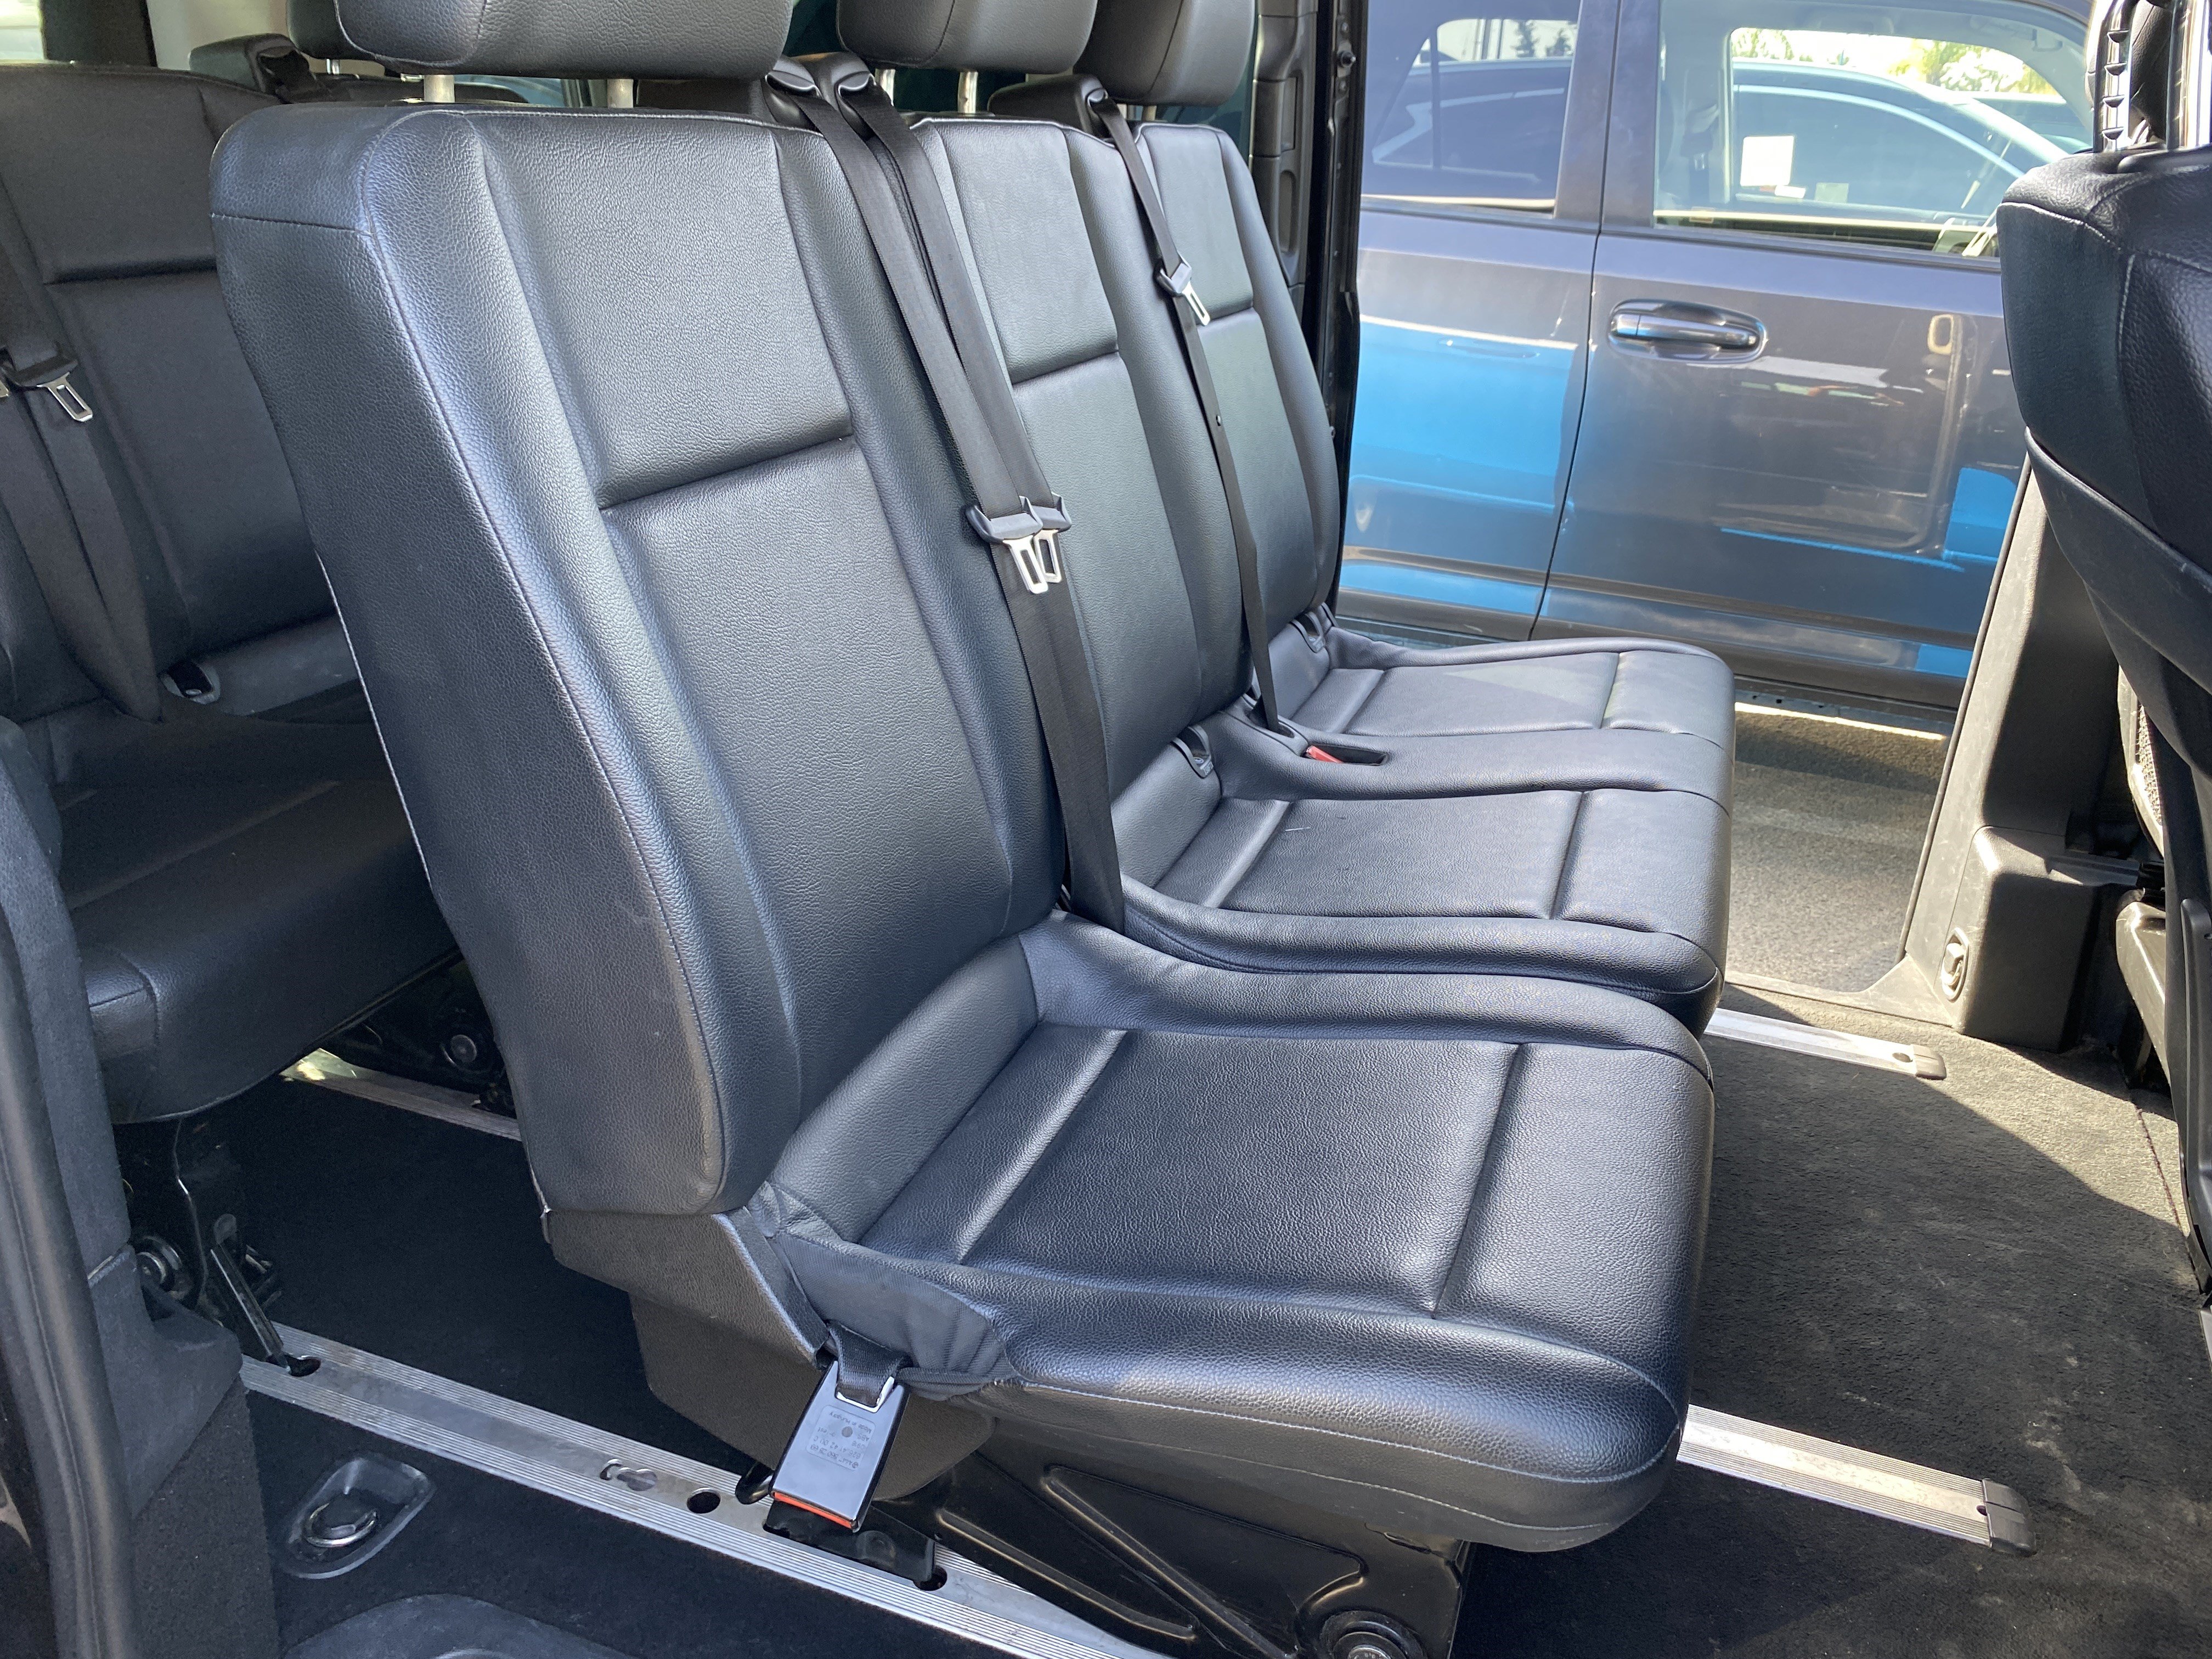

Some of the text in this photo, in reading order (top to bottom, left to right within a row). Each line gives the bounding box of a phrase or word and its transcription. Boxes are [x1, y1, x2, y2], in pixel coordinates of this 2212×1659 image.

[829, 1411, 851, 1424] Hungary
[858, 1424, 872, 1434] Made
[857, 1434, 870, 1442] ABS
